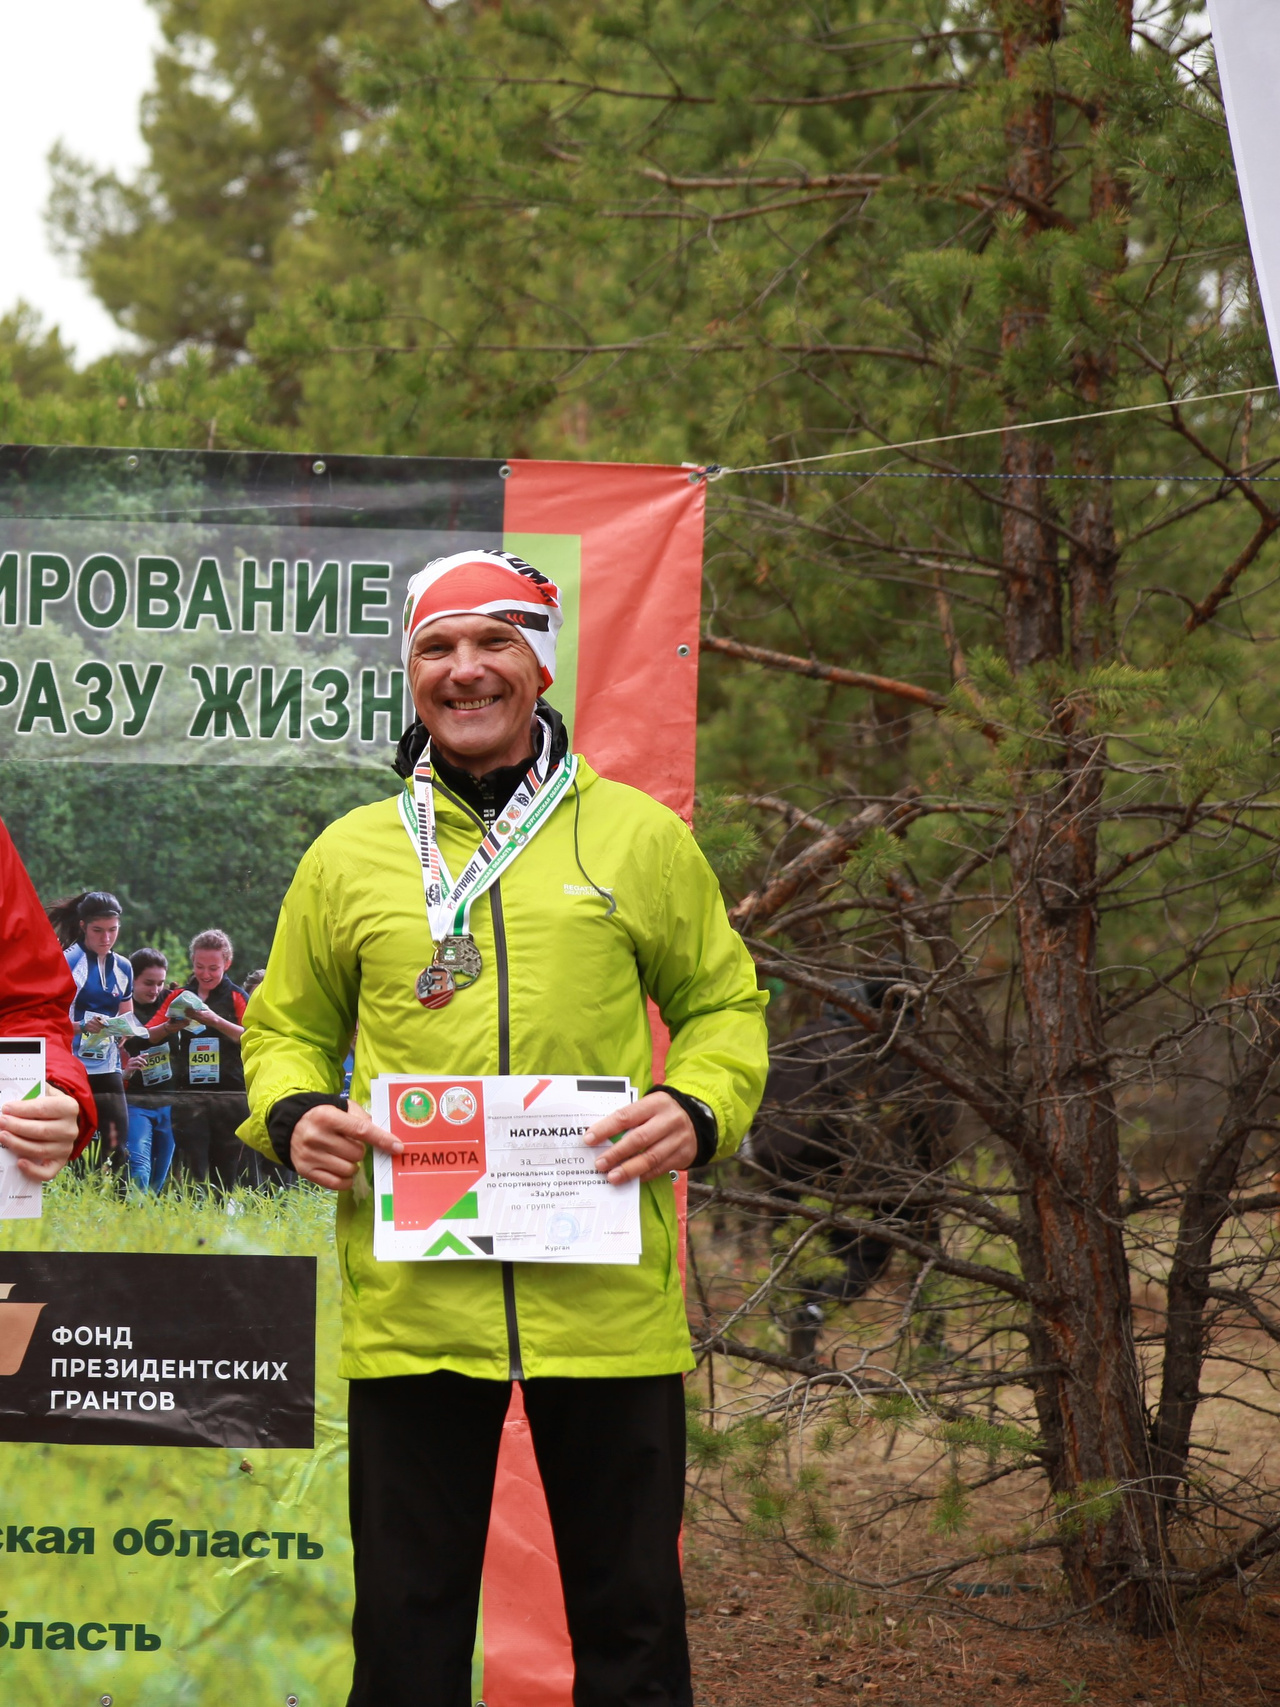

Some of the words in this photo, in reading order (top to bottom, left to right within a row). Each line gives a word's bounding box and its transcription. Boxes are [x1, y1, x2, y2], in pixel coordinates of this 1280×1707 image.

[188, 664, 407, 743] ЖИЗН
[524, 798, 551, 829] КУРГАНСКАЯ
[549, 776, 567, 799] ОБЛАСТЬ
[191, 1053, 216, 1063] 4501
[509, 1126, 590, 1138] НАГРАЖДАЕТ
[400, 1150, 480, 1167] ГРАМОТА
[554, 1156, 585, 1165] место
[496, 1171, 554, 1179] региональных
[486, 1181, 497, 1189] по
[498, 1180, 552, 1190] спортивному
[553, 1179, 611, 1188] ориентирован
[526, 1203, 557, 1211] группе
[544, 1244, 571, 1252] Курган
[51, 1325, 134, 1350] ФОНД
[50, 1356, 289, 1382] ПРЕЗИДЕНТСКИХ
[49, 1389, 176, 1412] ГРАНТОВ
[112, 1519, 324, 1560] область
